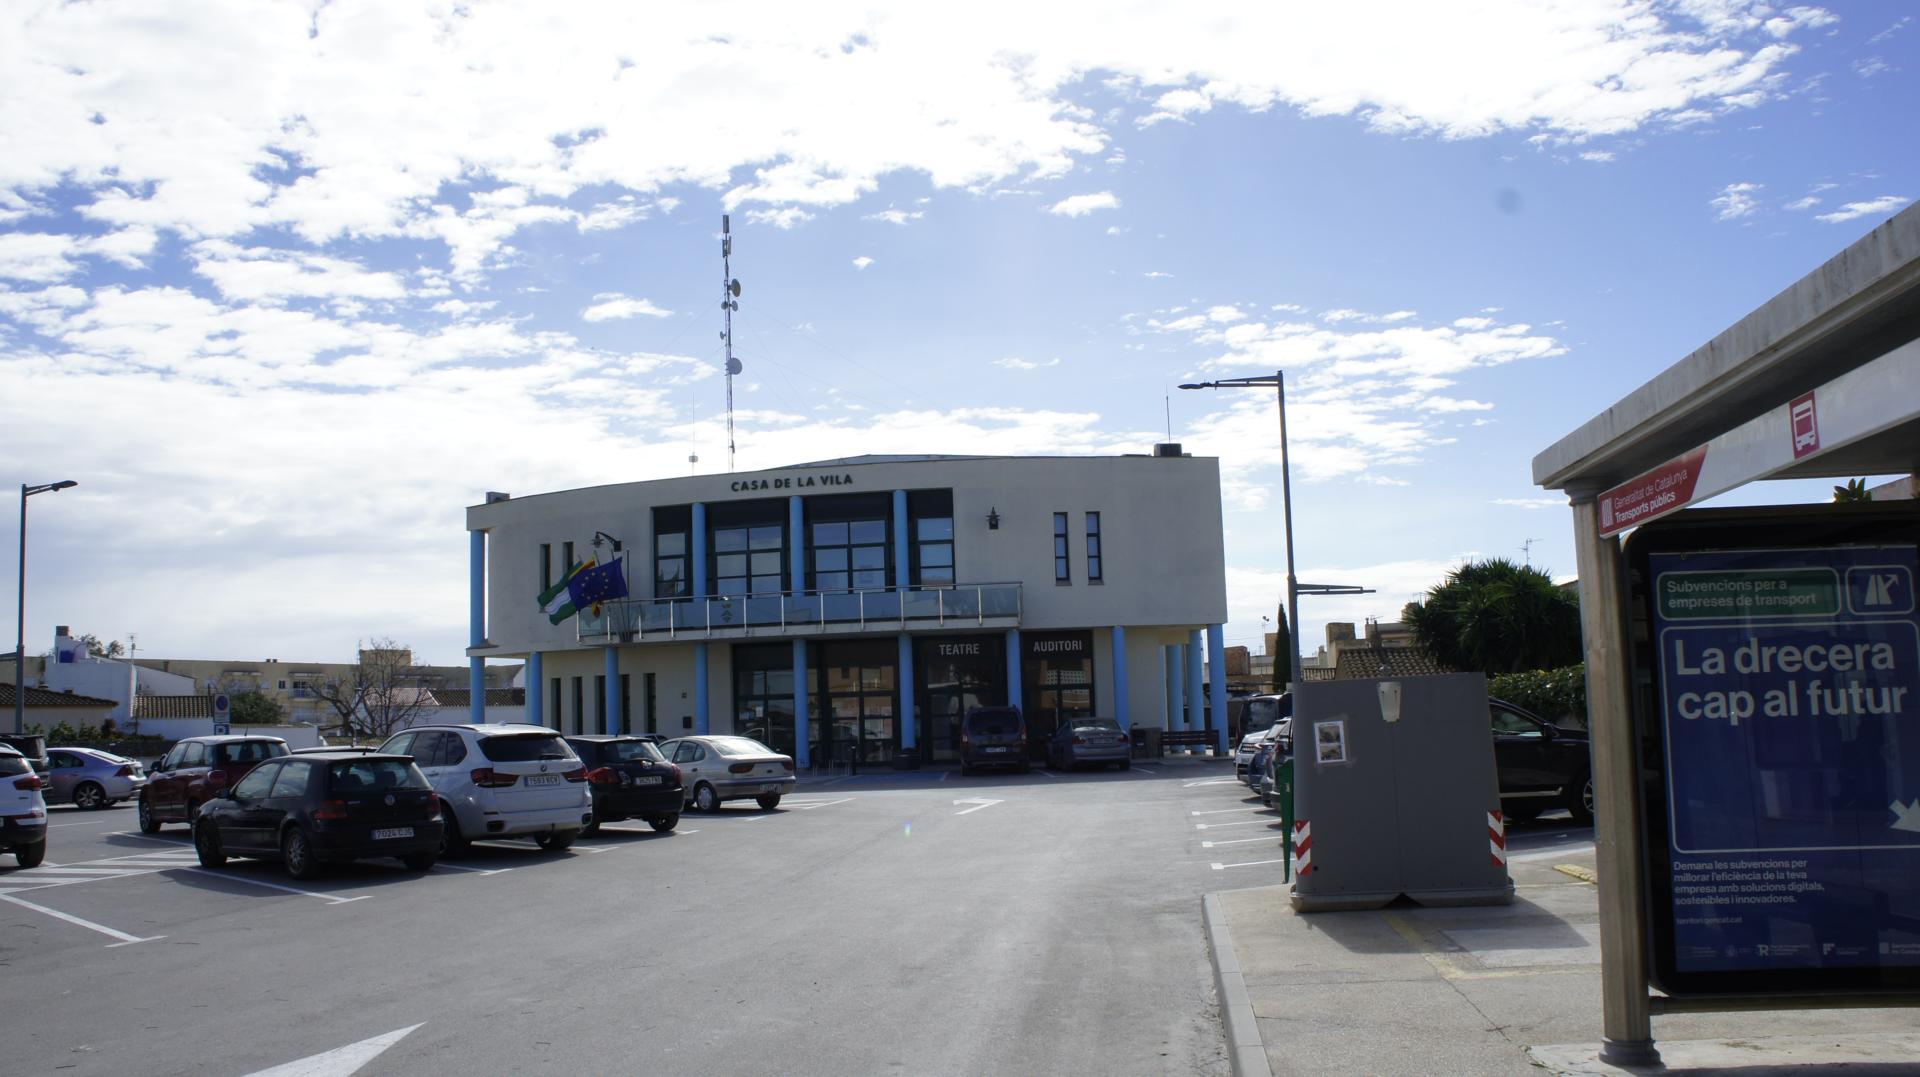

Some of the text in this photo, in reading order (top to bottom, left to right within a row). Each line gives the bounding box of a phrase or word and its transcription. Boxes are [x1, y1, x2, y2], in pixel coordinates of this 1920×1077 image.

[731, 474, 853, 492] CASA DE LA VILA
[1614, 469, 1688, 509] Generalitat de Catalunya
[1615, 491, 1676, 523] Transports públics
[1666, 579, 1787, 593] Subvencions per a
[1668, 593, 1817, 610] empreses de transport
[938, 643, 980, 656] TEATRE
[1033, 640, 1082, 652] AUDITORI
[1675, 637, 1896, 676] La drecera
[1677, 679, 1908, 726] cap al futur
[1673, 859, 1808, 871] Demana les subvencions per
[1674, 873, 1710, 882] millorar
[1762, 871, 1775, 880] de
[1776, 871, 1785, 880] la
[1786, 871, 1808, 880] teva
[1675, 882, 1825, 895] empresa amb solucions digitals,
[1676, 896, 1730, 906] sostenibles
[1735, 894, 1797, 905] innovadores.
